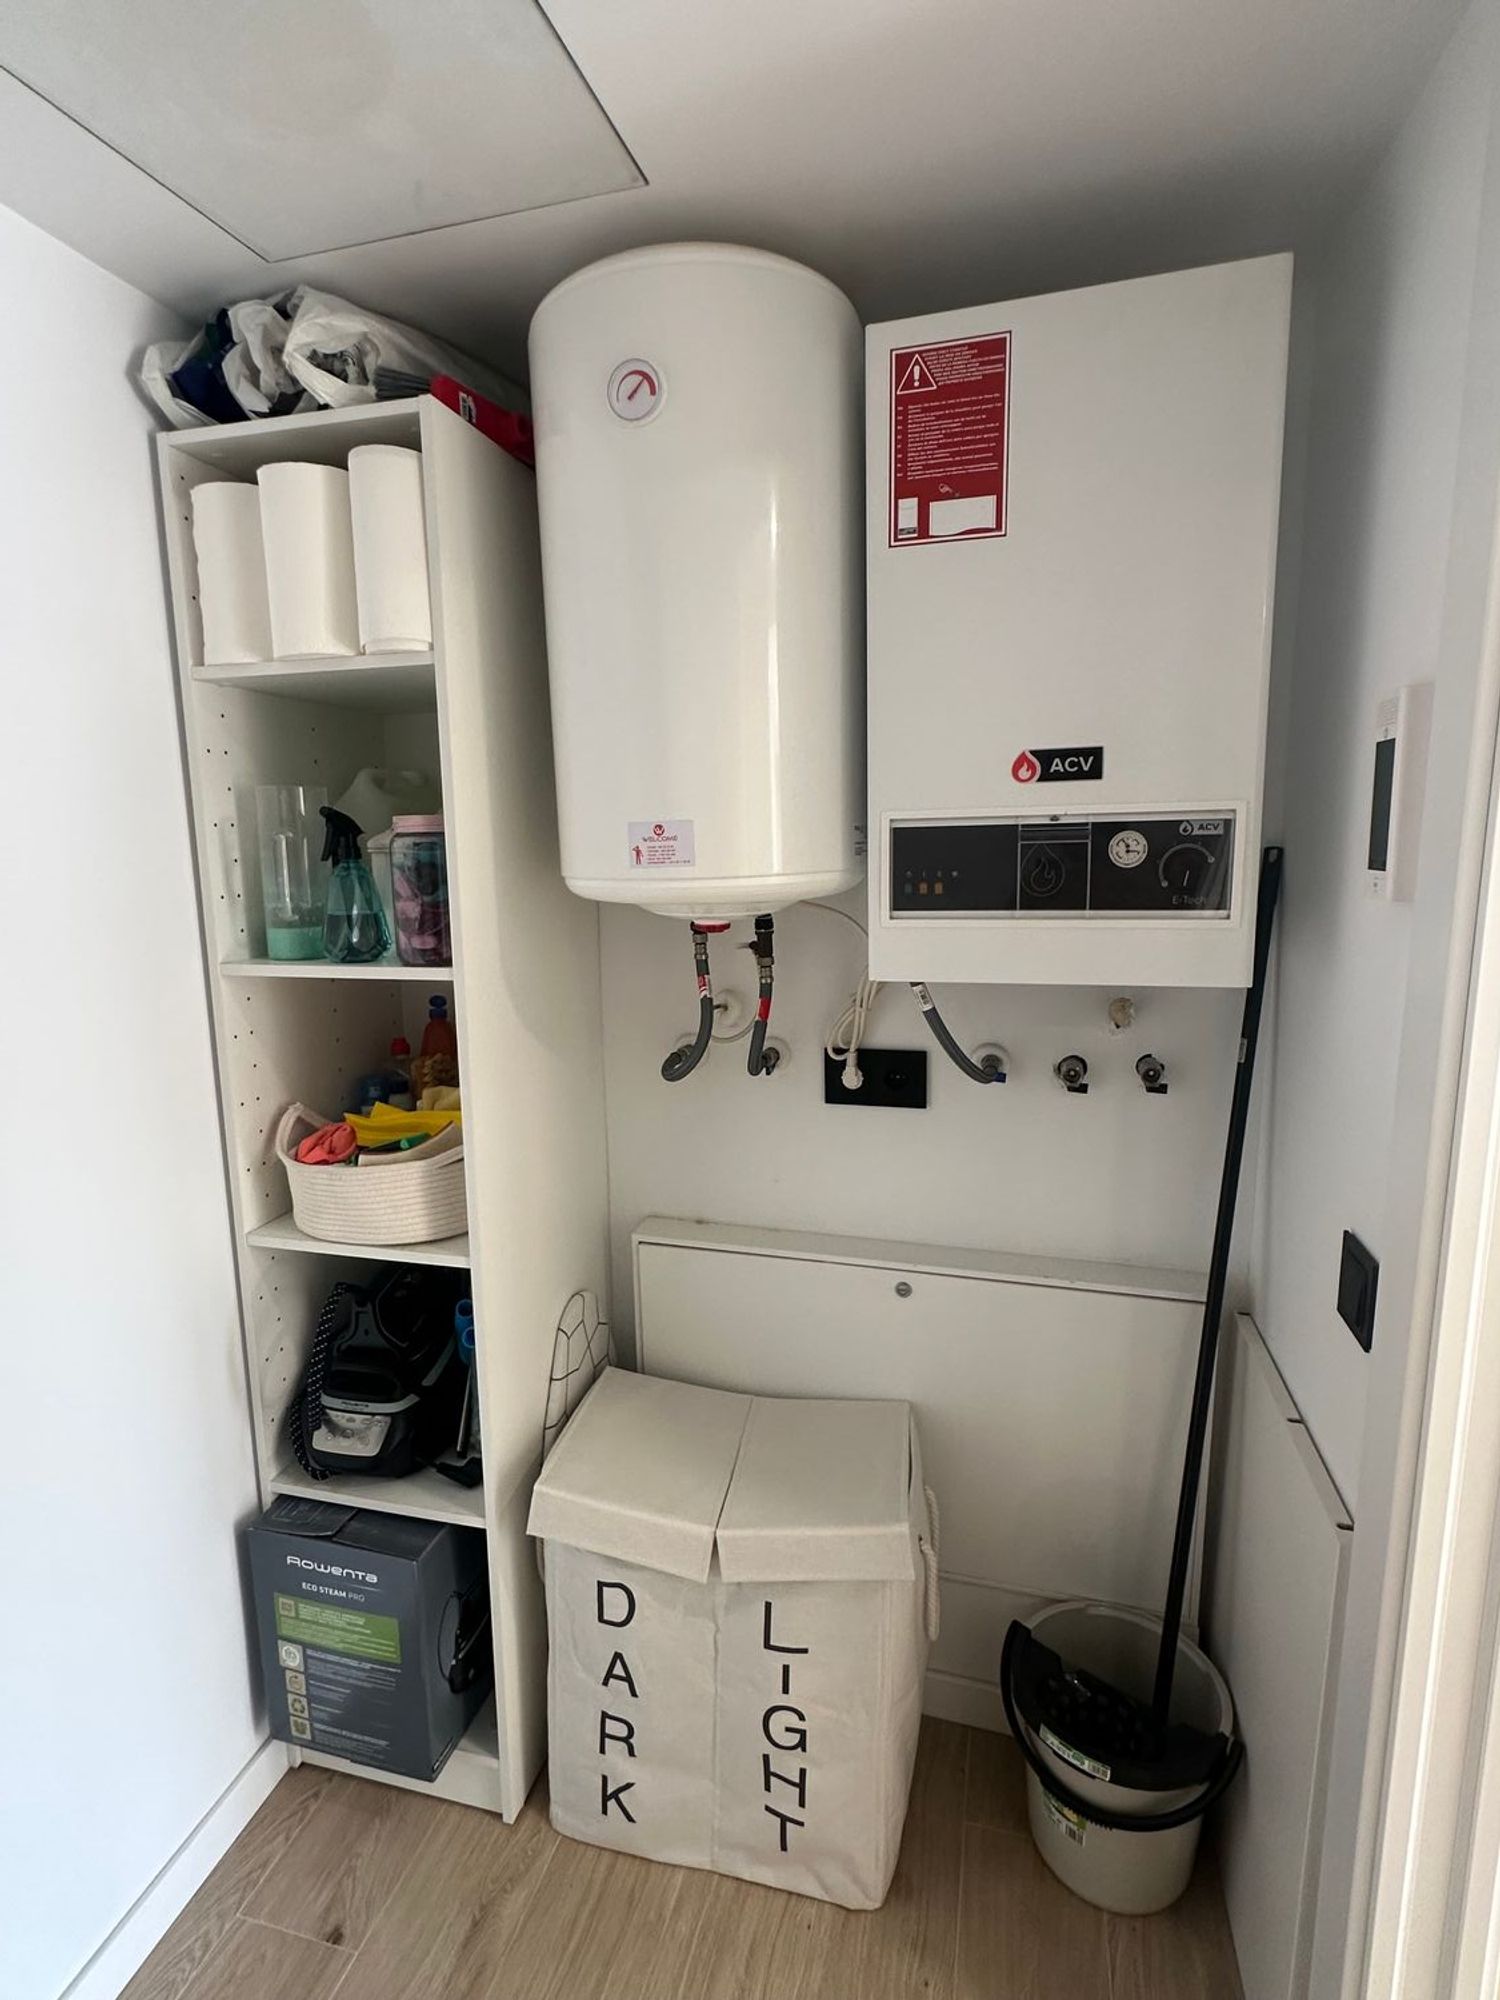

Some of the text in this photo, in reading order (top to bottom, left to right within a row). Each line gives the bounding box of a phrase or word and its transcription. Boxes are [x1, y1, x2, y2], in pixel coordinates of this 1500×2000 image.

[1049, 755, 1094, 773] ACV
[1197, 822, 1220, 832] ACV
[302, 1581, 365, 1603] ECO STEAM PRO
[597, 1580, 639, 1824] DARK
[762, 1601, 809, 1852] LIGHT
